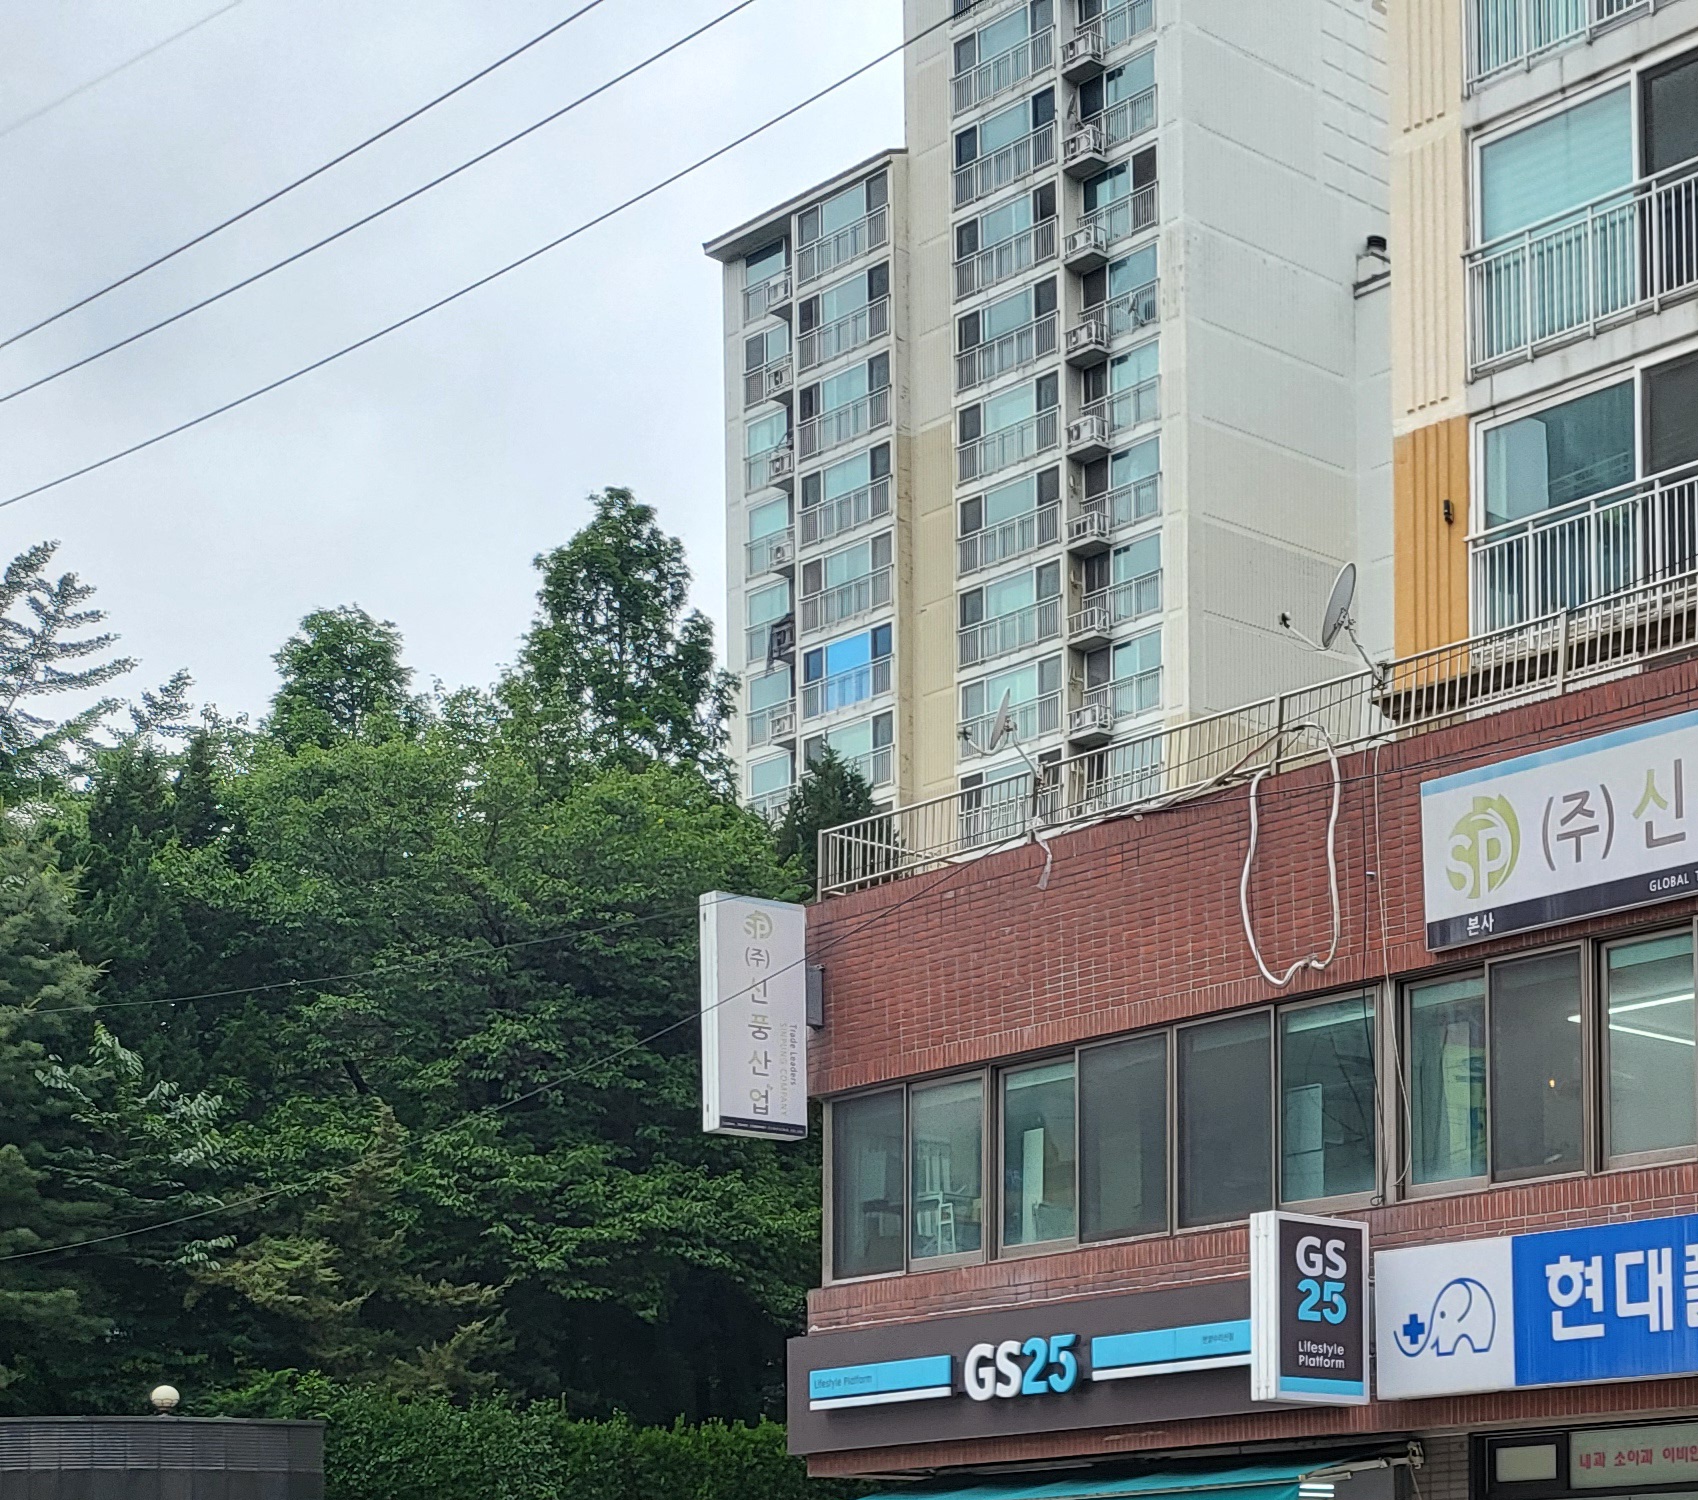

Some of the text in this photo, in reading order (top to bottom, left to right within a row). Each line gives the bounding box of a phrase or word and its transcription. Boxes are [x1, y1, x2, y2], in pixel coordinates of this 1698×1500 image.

[1649, 874, 1690, 892] GLOBAL
[1467, 912, 1494, 936] 본사
[789, 1024, 798, 1049] Trade
[1296, 1235, 1348, 1279] GS
[1296, 1278, 1348, 1325] 25
[1298, 1340, 1345, 1358] Lifestyle
[964, 1333, 1080, 1401] GS25
[1298, 1354, 1345, 1369] Platform
[1580, 1452, 1606, 1469] 내과
[1614, 1448, 1653, 1466] 소아과
